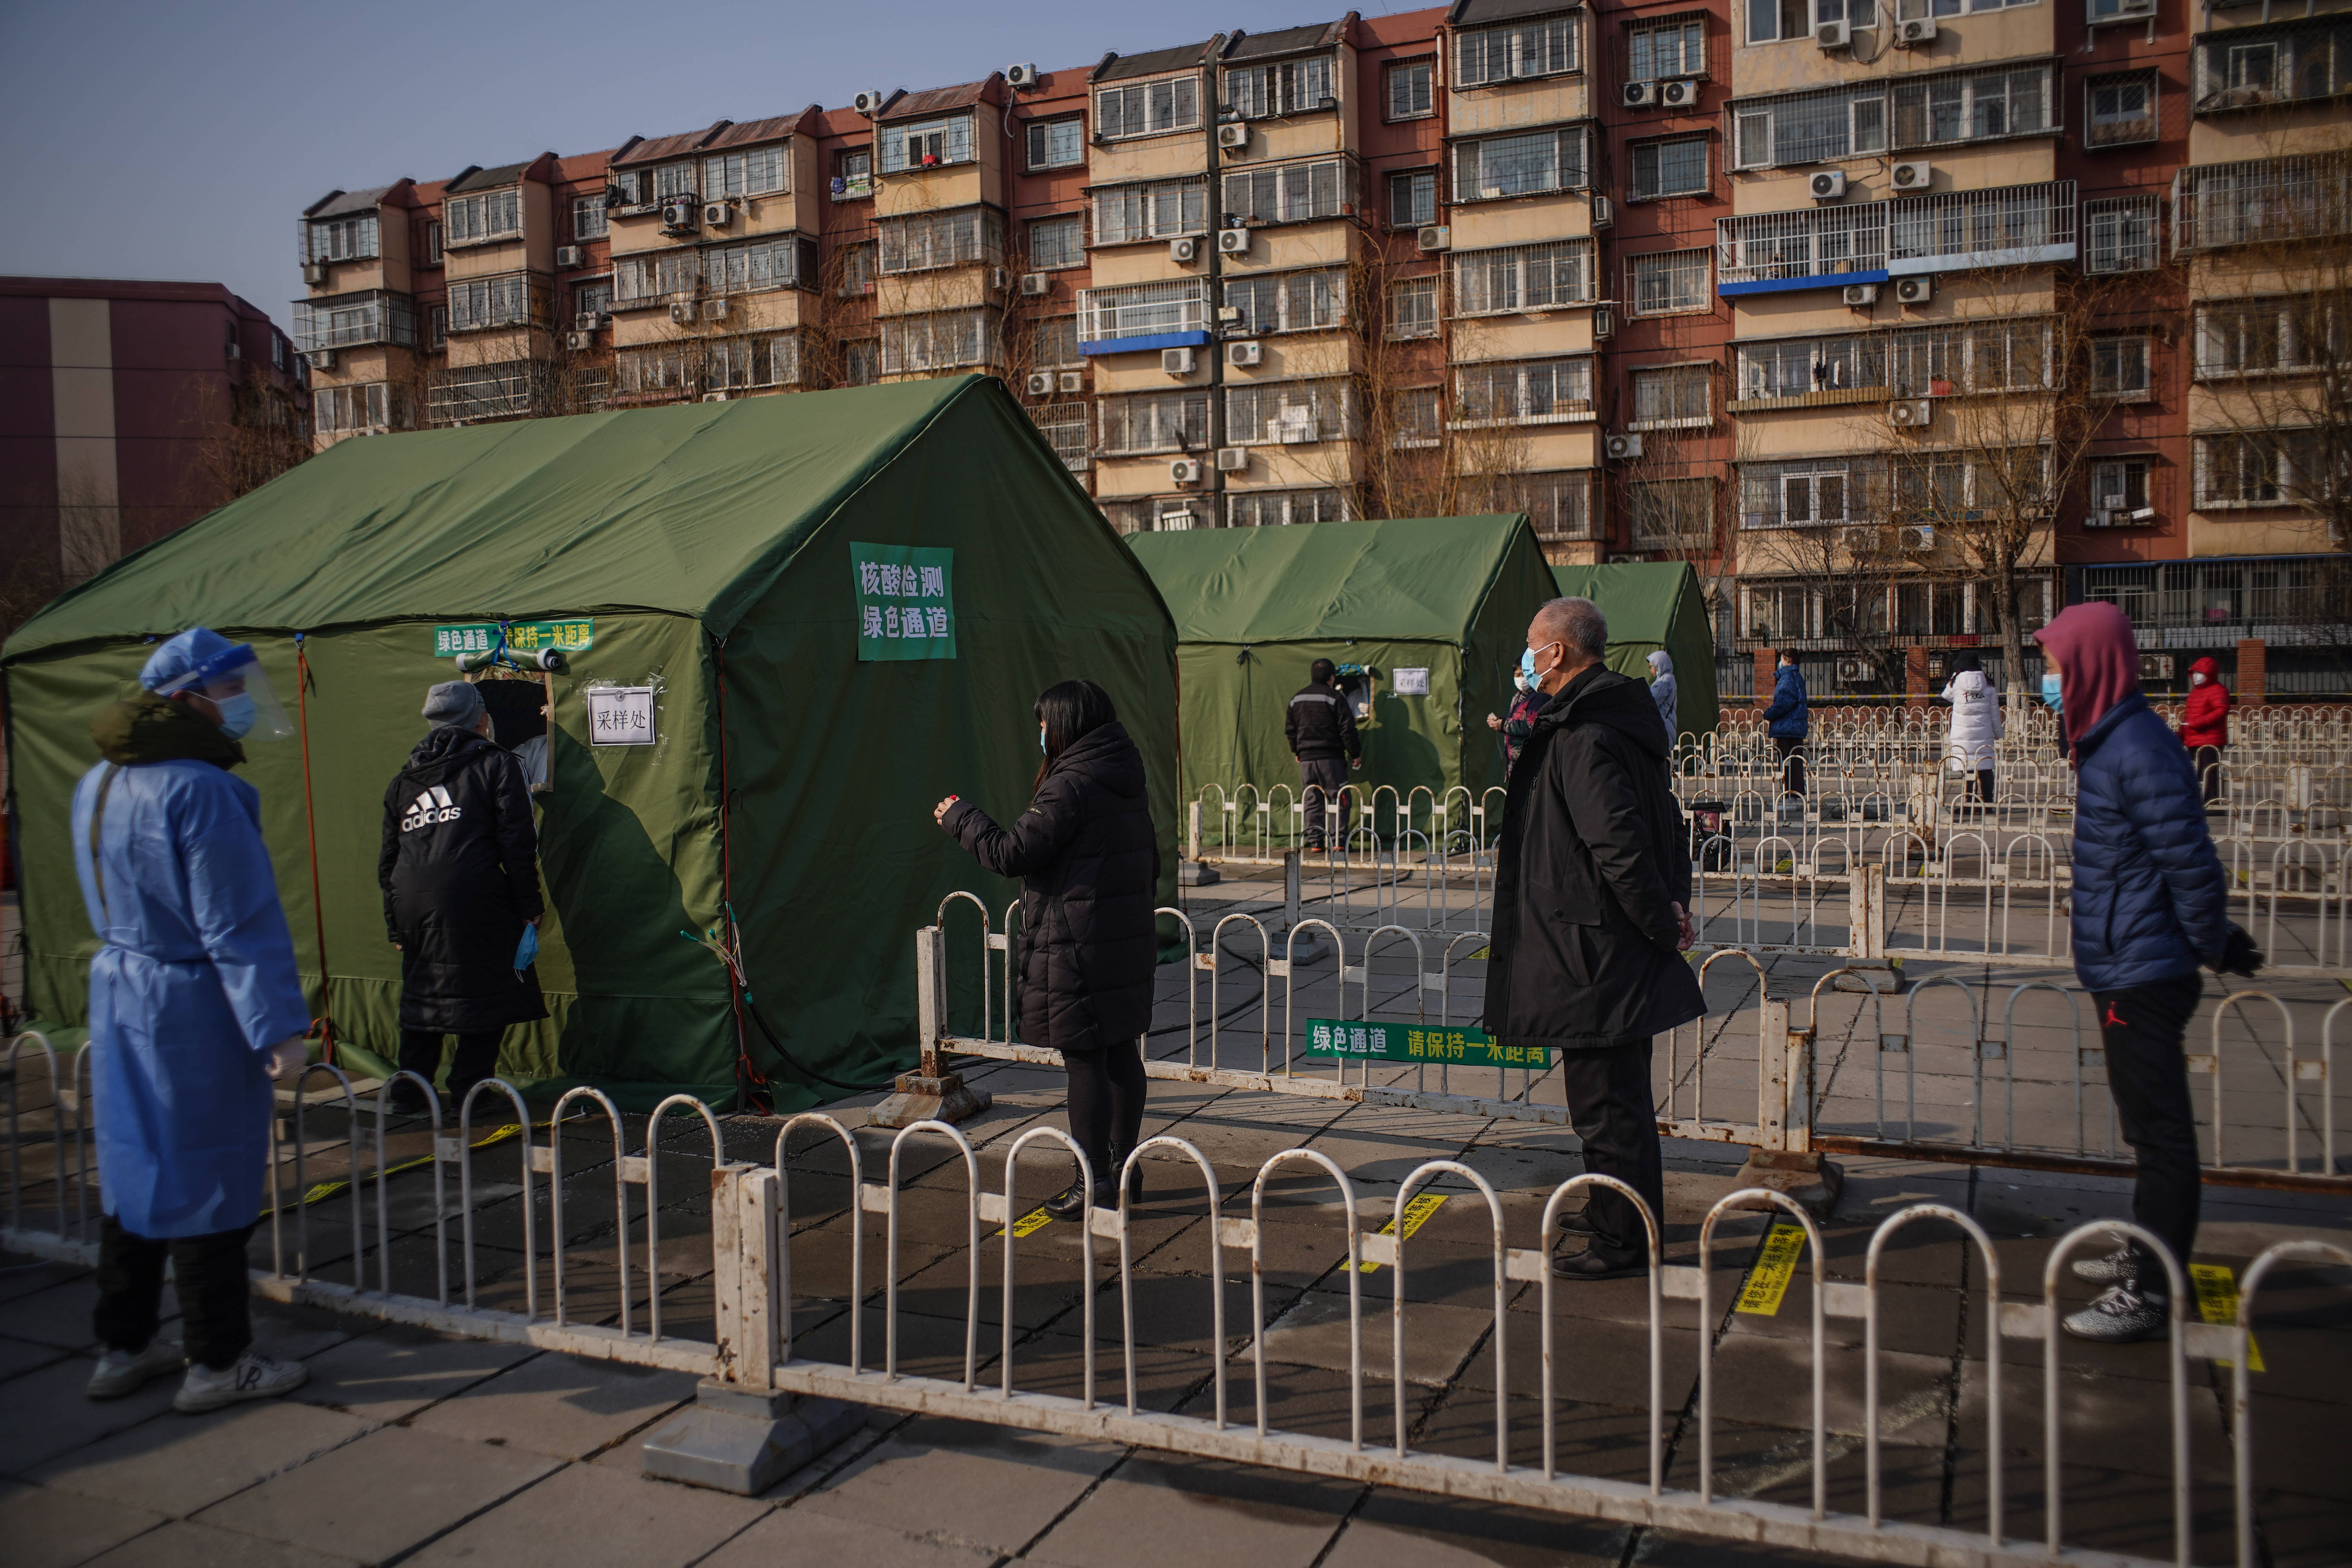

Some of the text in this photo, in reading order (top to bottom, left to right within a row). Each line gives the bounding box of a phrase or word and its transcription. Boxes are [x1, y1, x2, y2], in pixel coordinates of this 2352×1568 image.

[860, 561, 944, 597] 核酸检测
[864, 605, 948, 639] 绿色通道
[438, 629, 488, 652] 绿色通道
[1398, 679, 1424, 687] 采样处
[597, 710, 646, 730] 采样处
[402, 806, 461, 832] adidas
[1313, 1025, 1387, 1053] 绿色通道
[1776, 1262, 1790, 1279] Outside
[1771, 1280, 1784, 1289] Wait
[1765, 1290, 1779, 1304] Please
